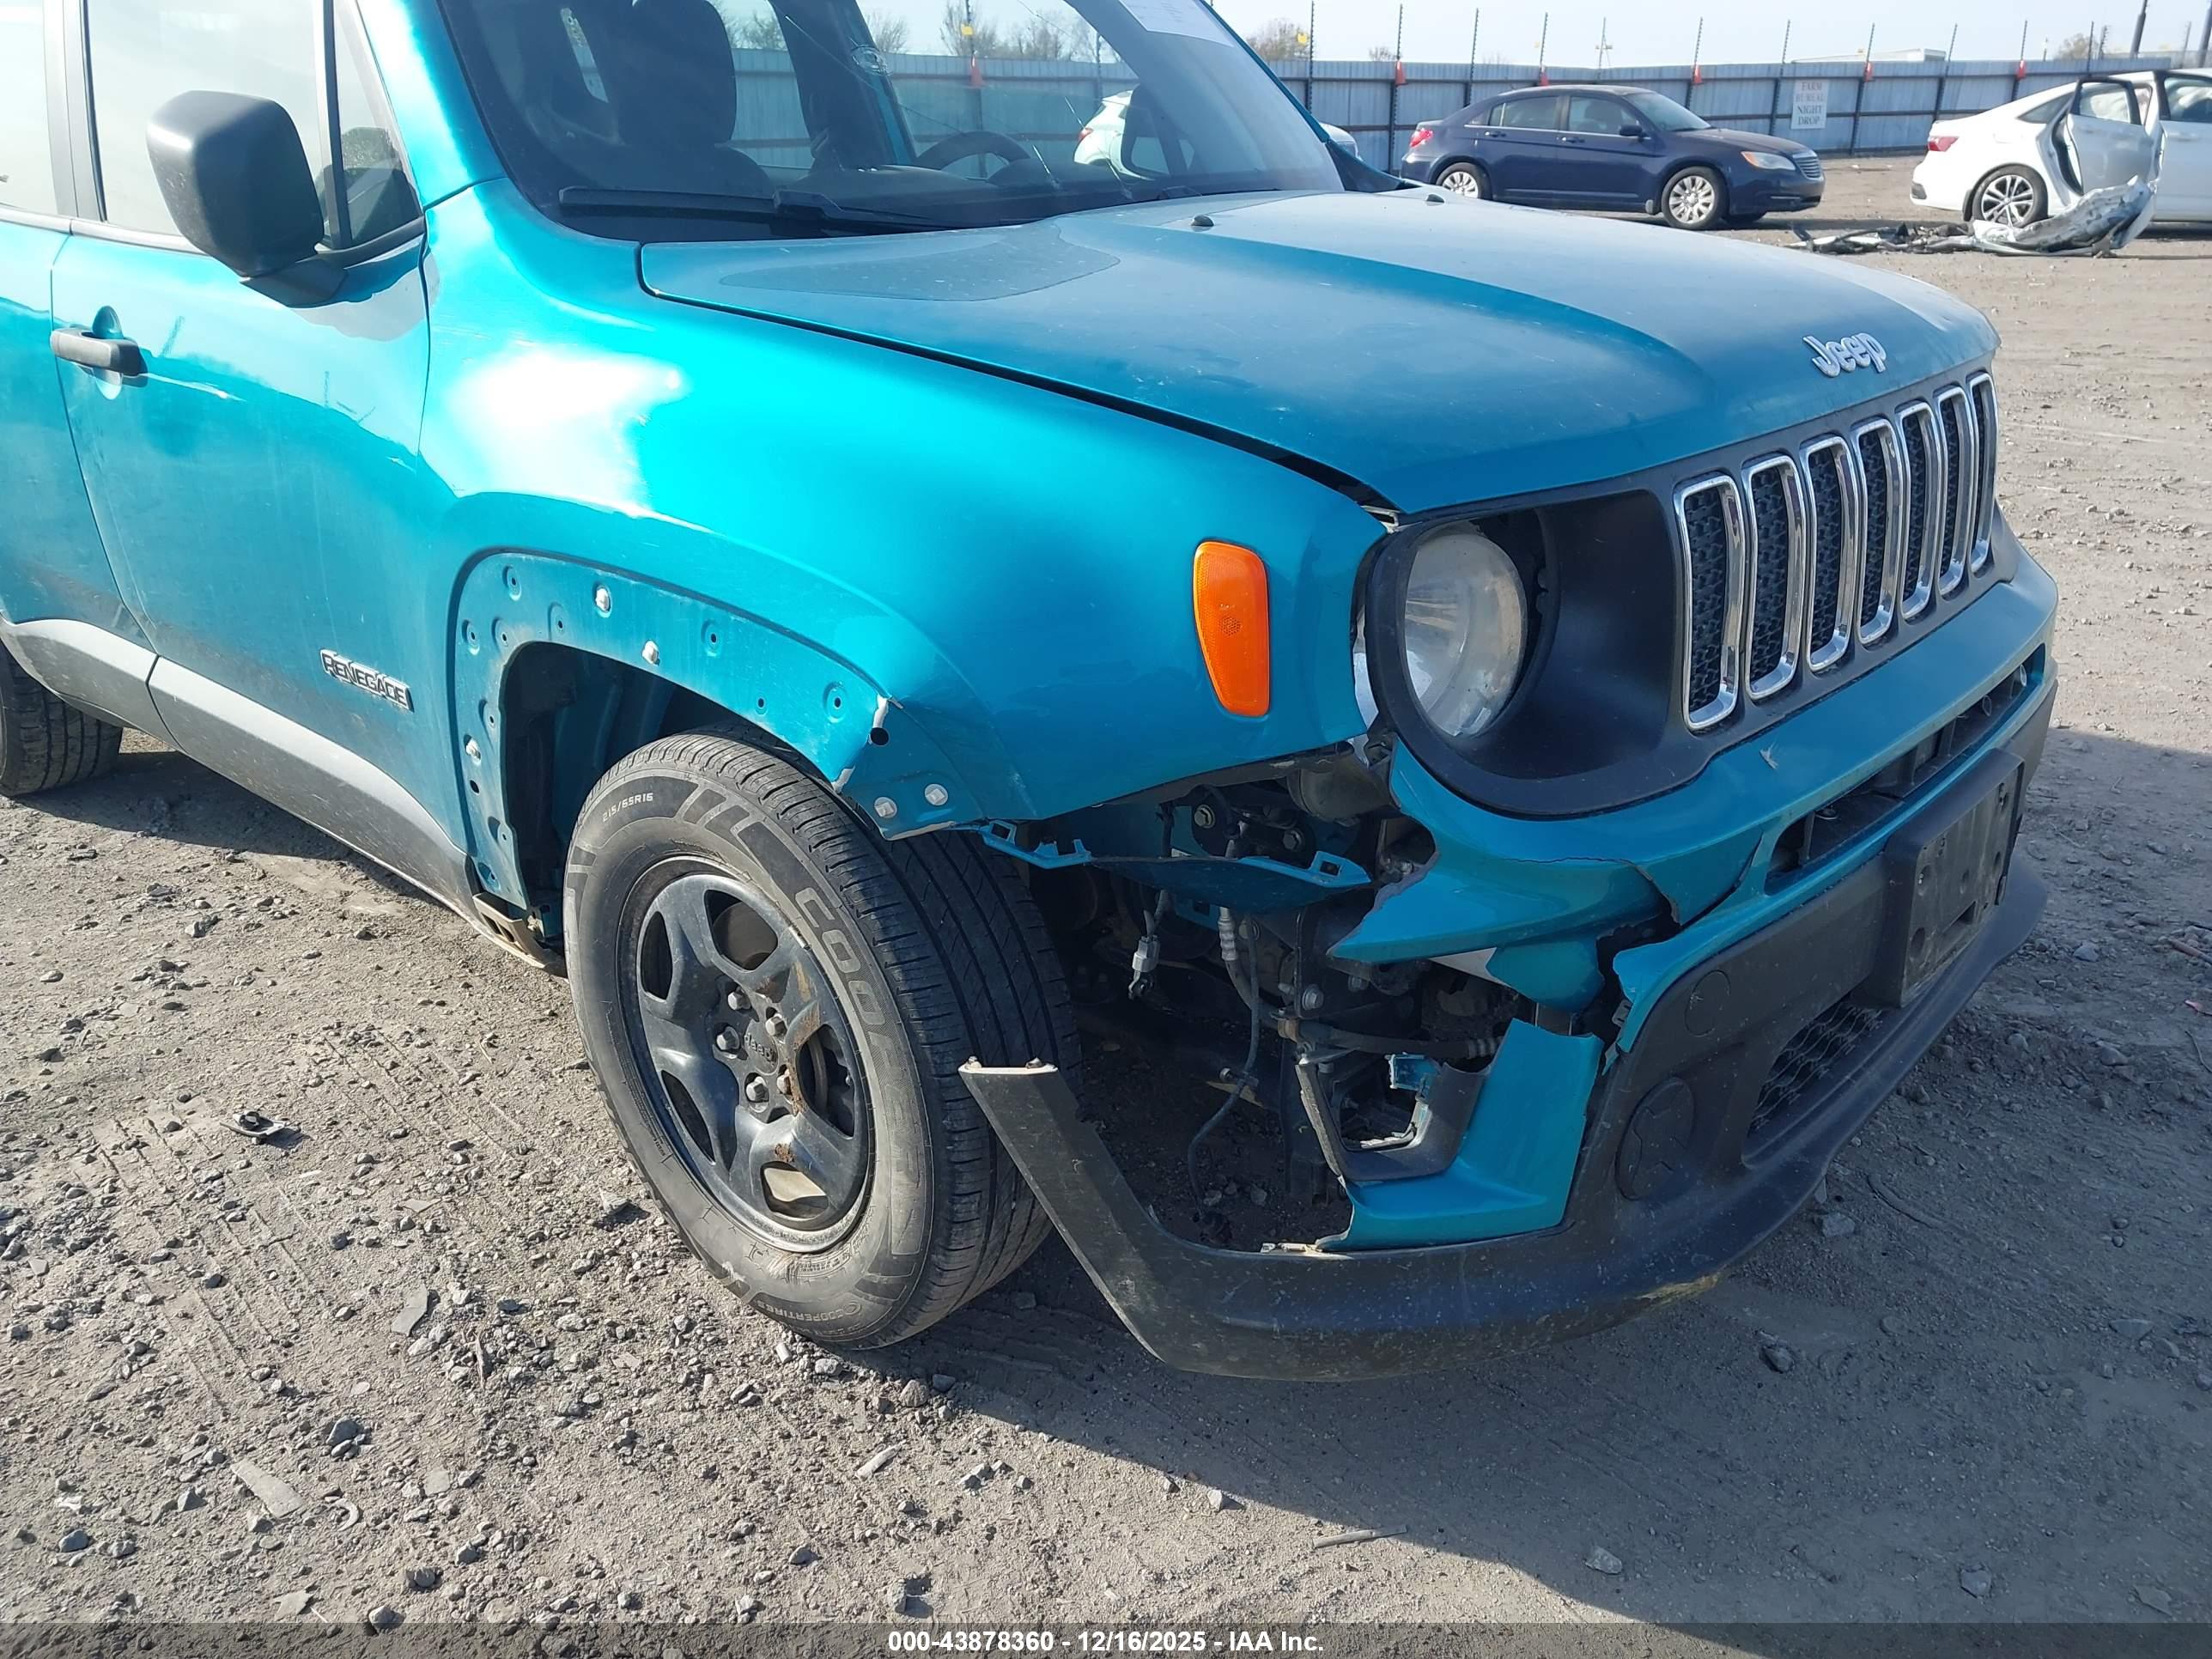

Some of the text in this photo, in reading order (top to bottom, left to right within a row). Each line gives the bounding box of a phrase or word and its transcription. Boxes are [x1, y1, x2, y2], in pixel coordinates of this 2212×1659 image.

[1802, 82, 1822, 91] FARM
[1796, 105, 1821, 114] NIGHT
[1798, 116, 1820, 125] DROP
[1802, 332, 1887, 377] Jeep
[321, 651, 410, 709] RENEGADE
[602, 792, 653, 823] 215/65R16
